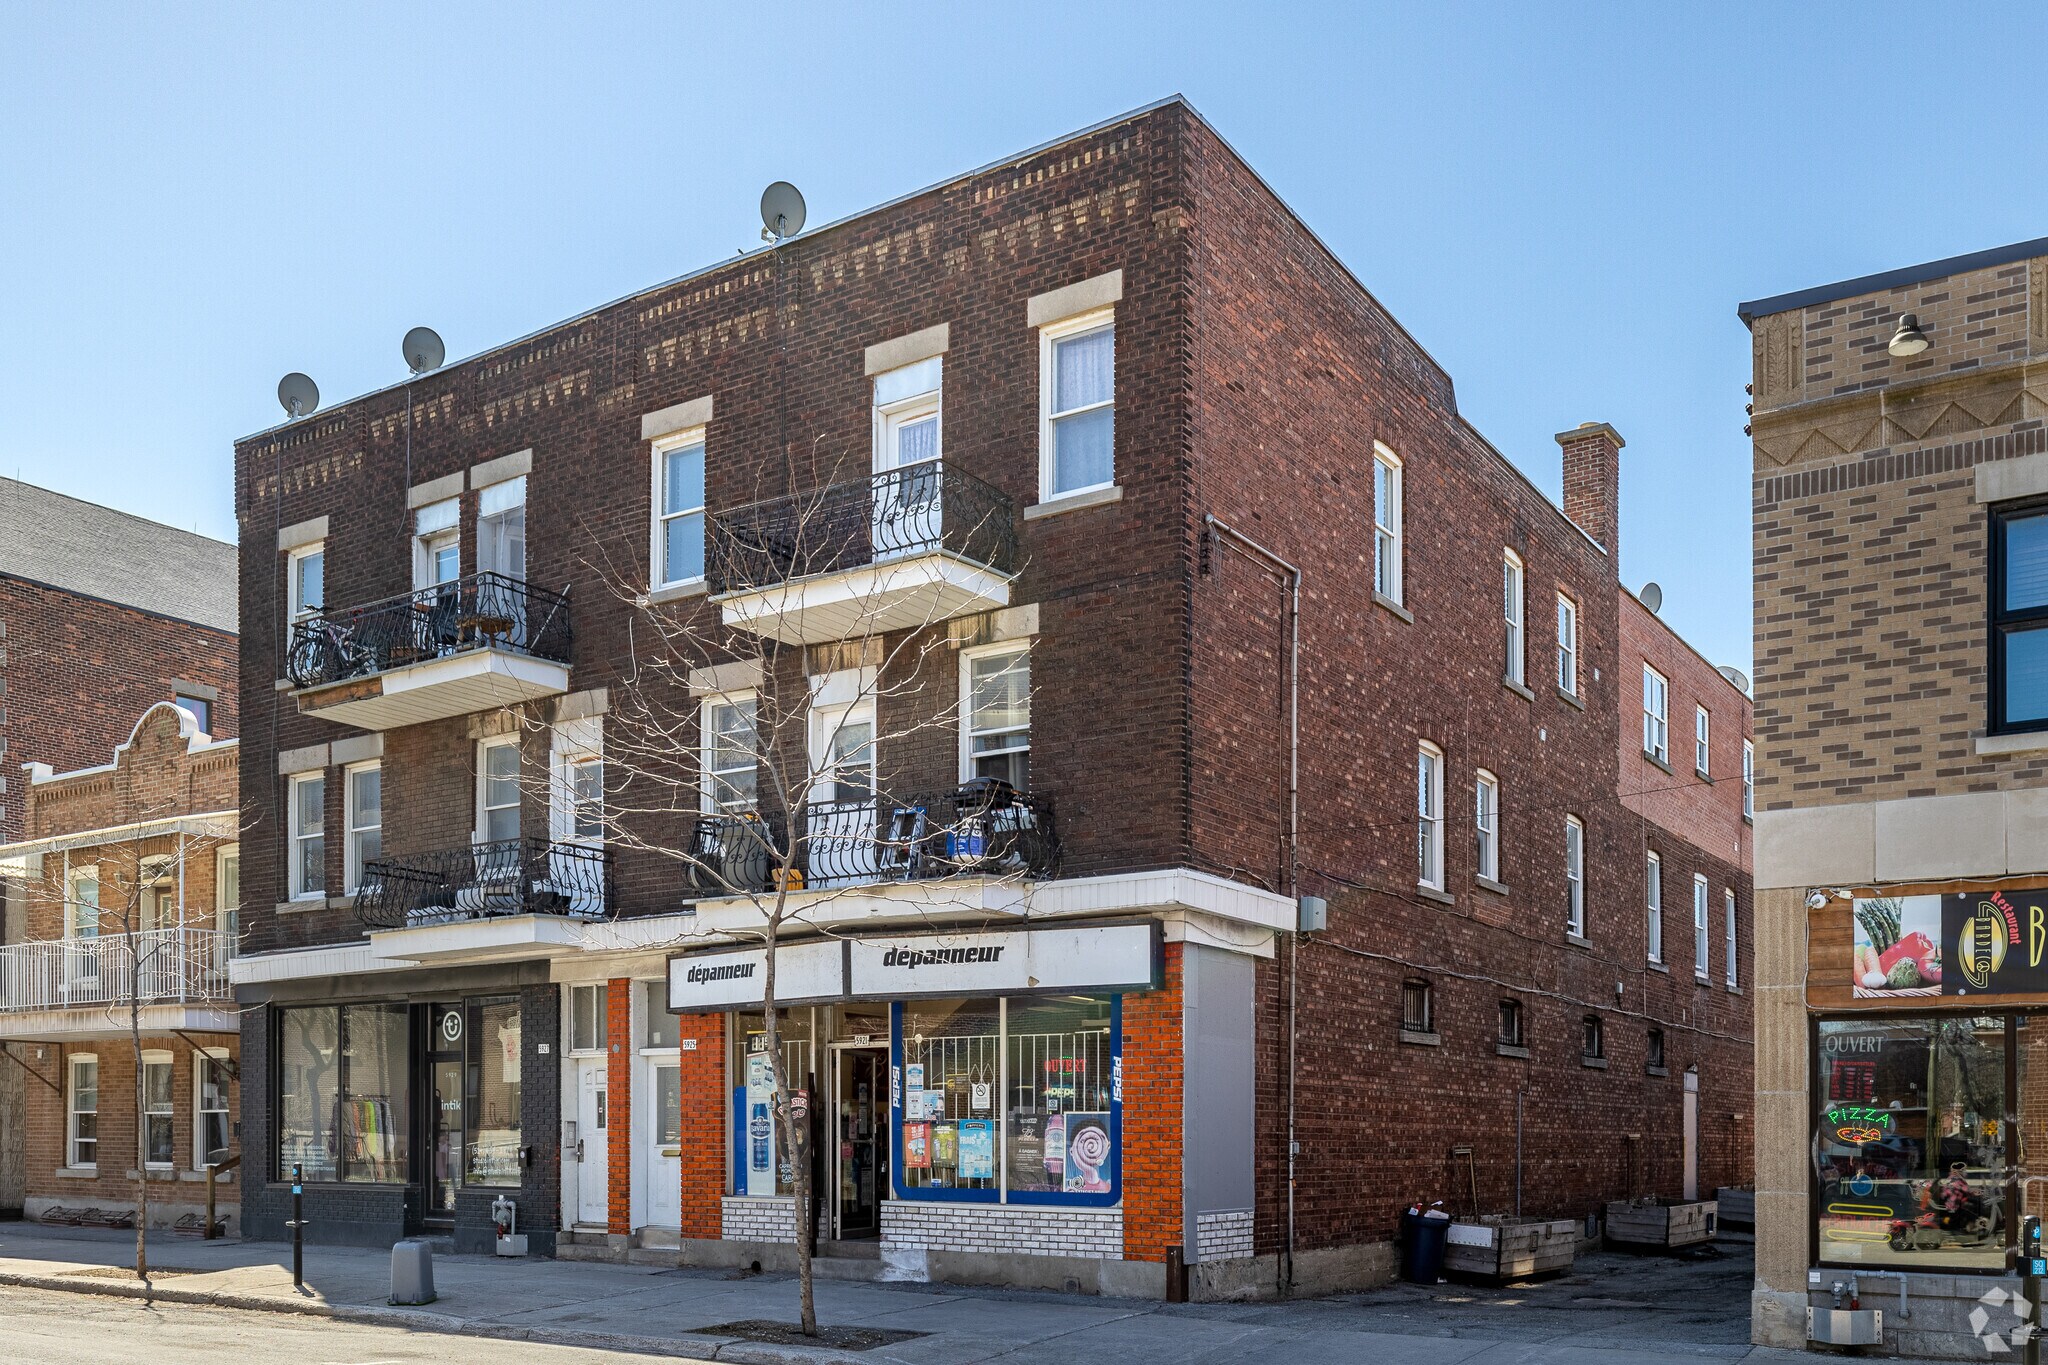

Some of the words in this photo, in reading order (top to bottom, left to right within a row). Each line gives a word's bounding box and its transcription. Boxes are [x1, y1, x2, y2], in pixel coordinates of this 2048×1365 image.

[1990, 890, 2022, 945] Restaurant
[882, 945, 1005, 970] dépanneur
[687, 962, 756, 985] dépanneur
[683, 1039, 697, 1049] 5925
[855, 1035, 869, 1045] 5921
[1825, 1036, 1885, 1053] OUVERT
[1043, 1058, 1087, 1073] OUVERT
[892, 1066, 901, 1109] PEPSI
[1113, 1056, 1122, 1102] PEPSI
[441, 1099, 462, 1111] intik
[1828, 1106, 1890, 1129] PIZZA
[2034, 1260, 2044, 1268] SQ
[2034, 1267, 2044, 1275] 212
